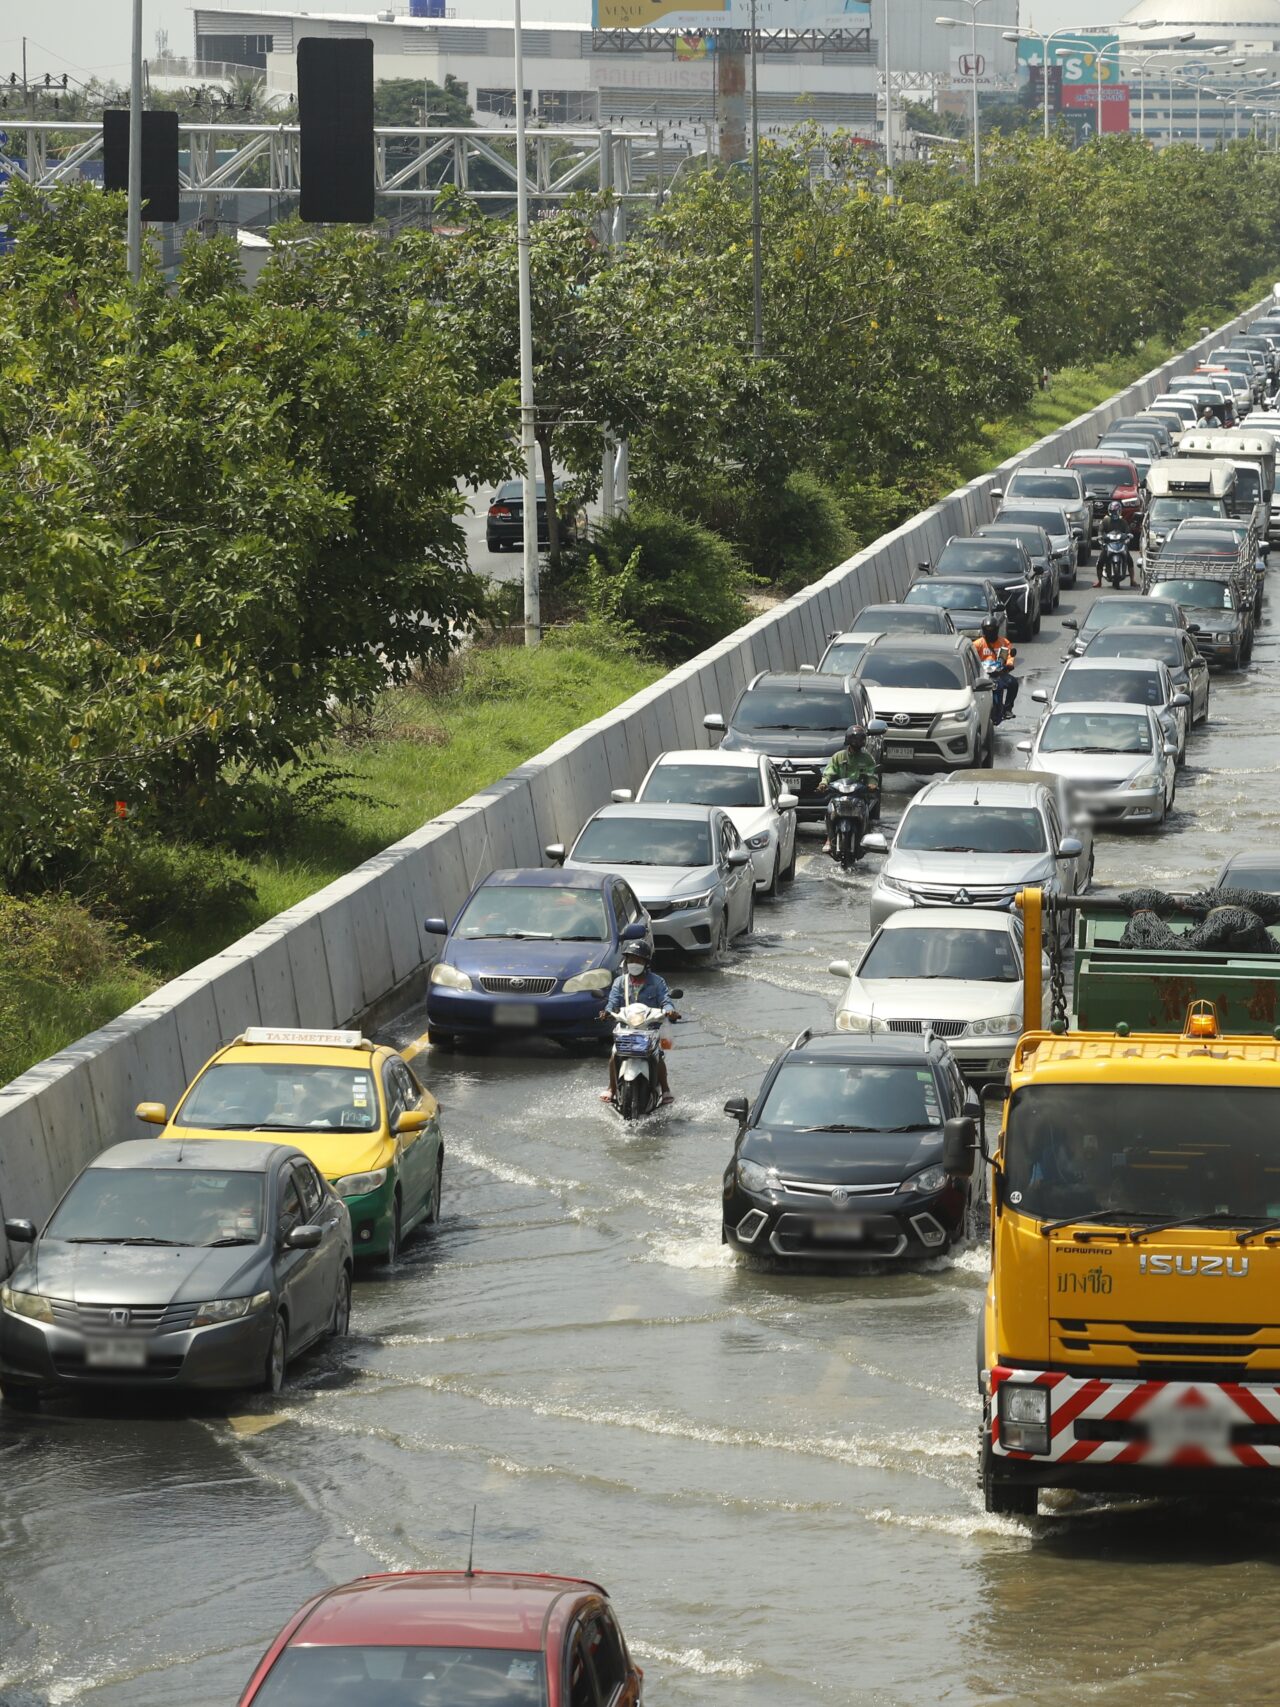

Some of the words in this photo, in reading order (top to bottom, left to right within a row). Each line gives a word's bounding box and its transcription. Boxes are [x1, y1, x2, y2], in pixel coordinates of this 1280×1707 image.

[604, 6, 643, 15] VENUE
[266, 1032, 342, 1042] TAXI-METER
[1056, 1247, 1112, 1255] FORWARD
[1139, 1254, 1249, 1277] ISUZU
